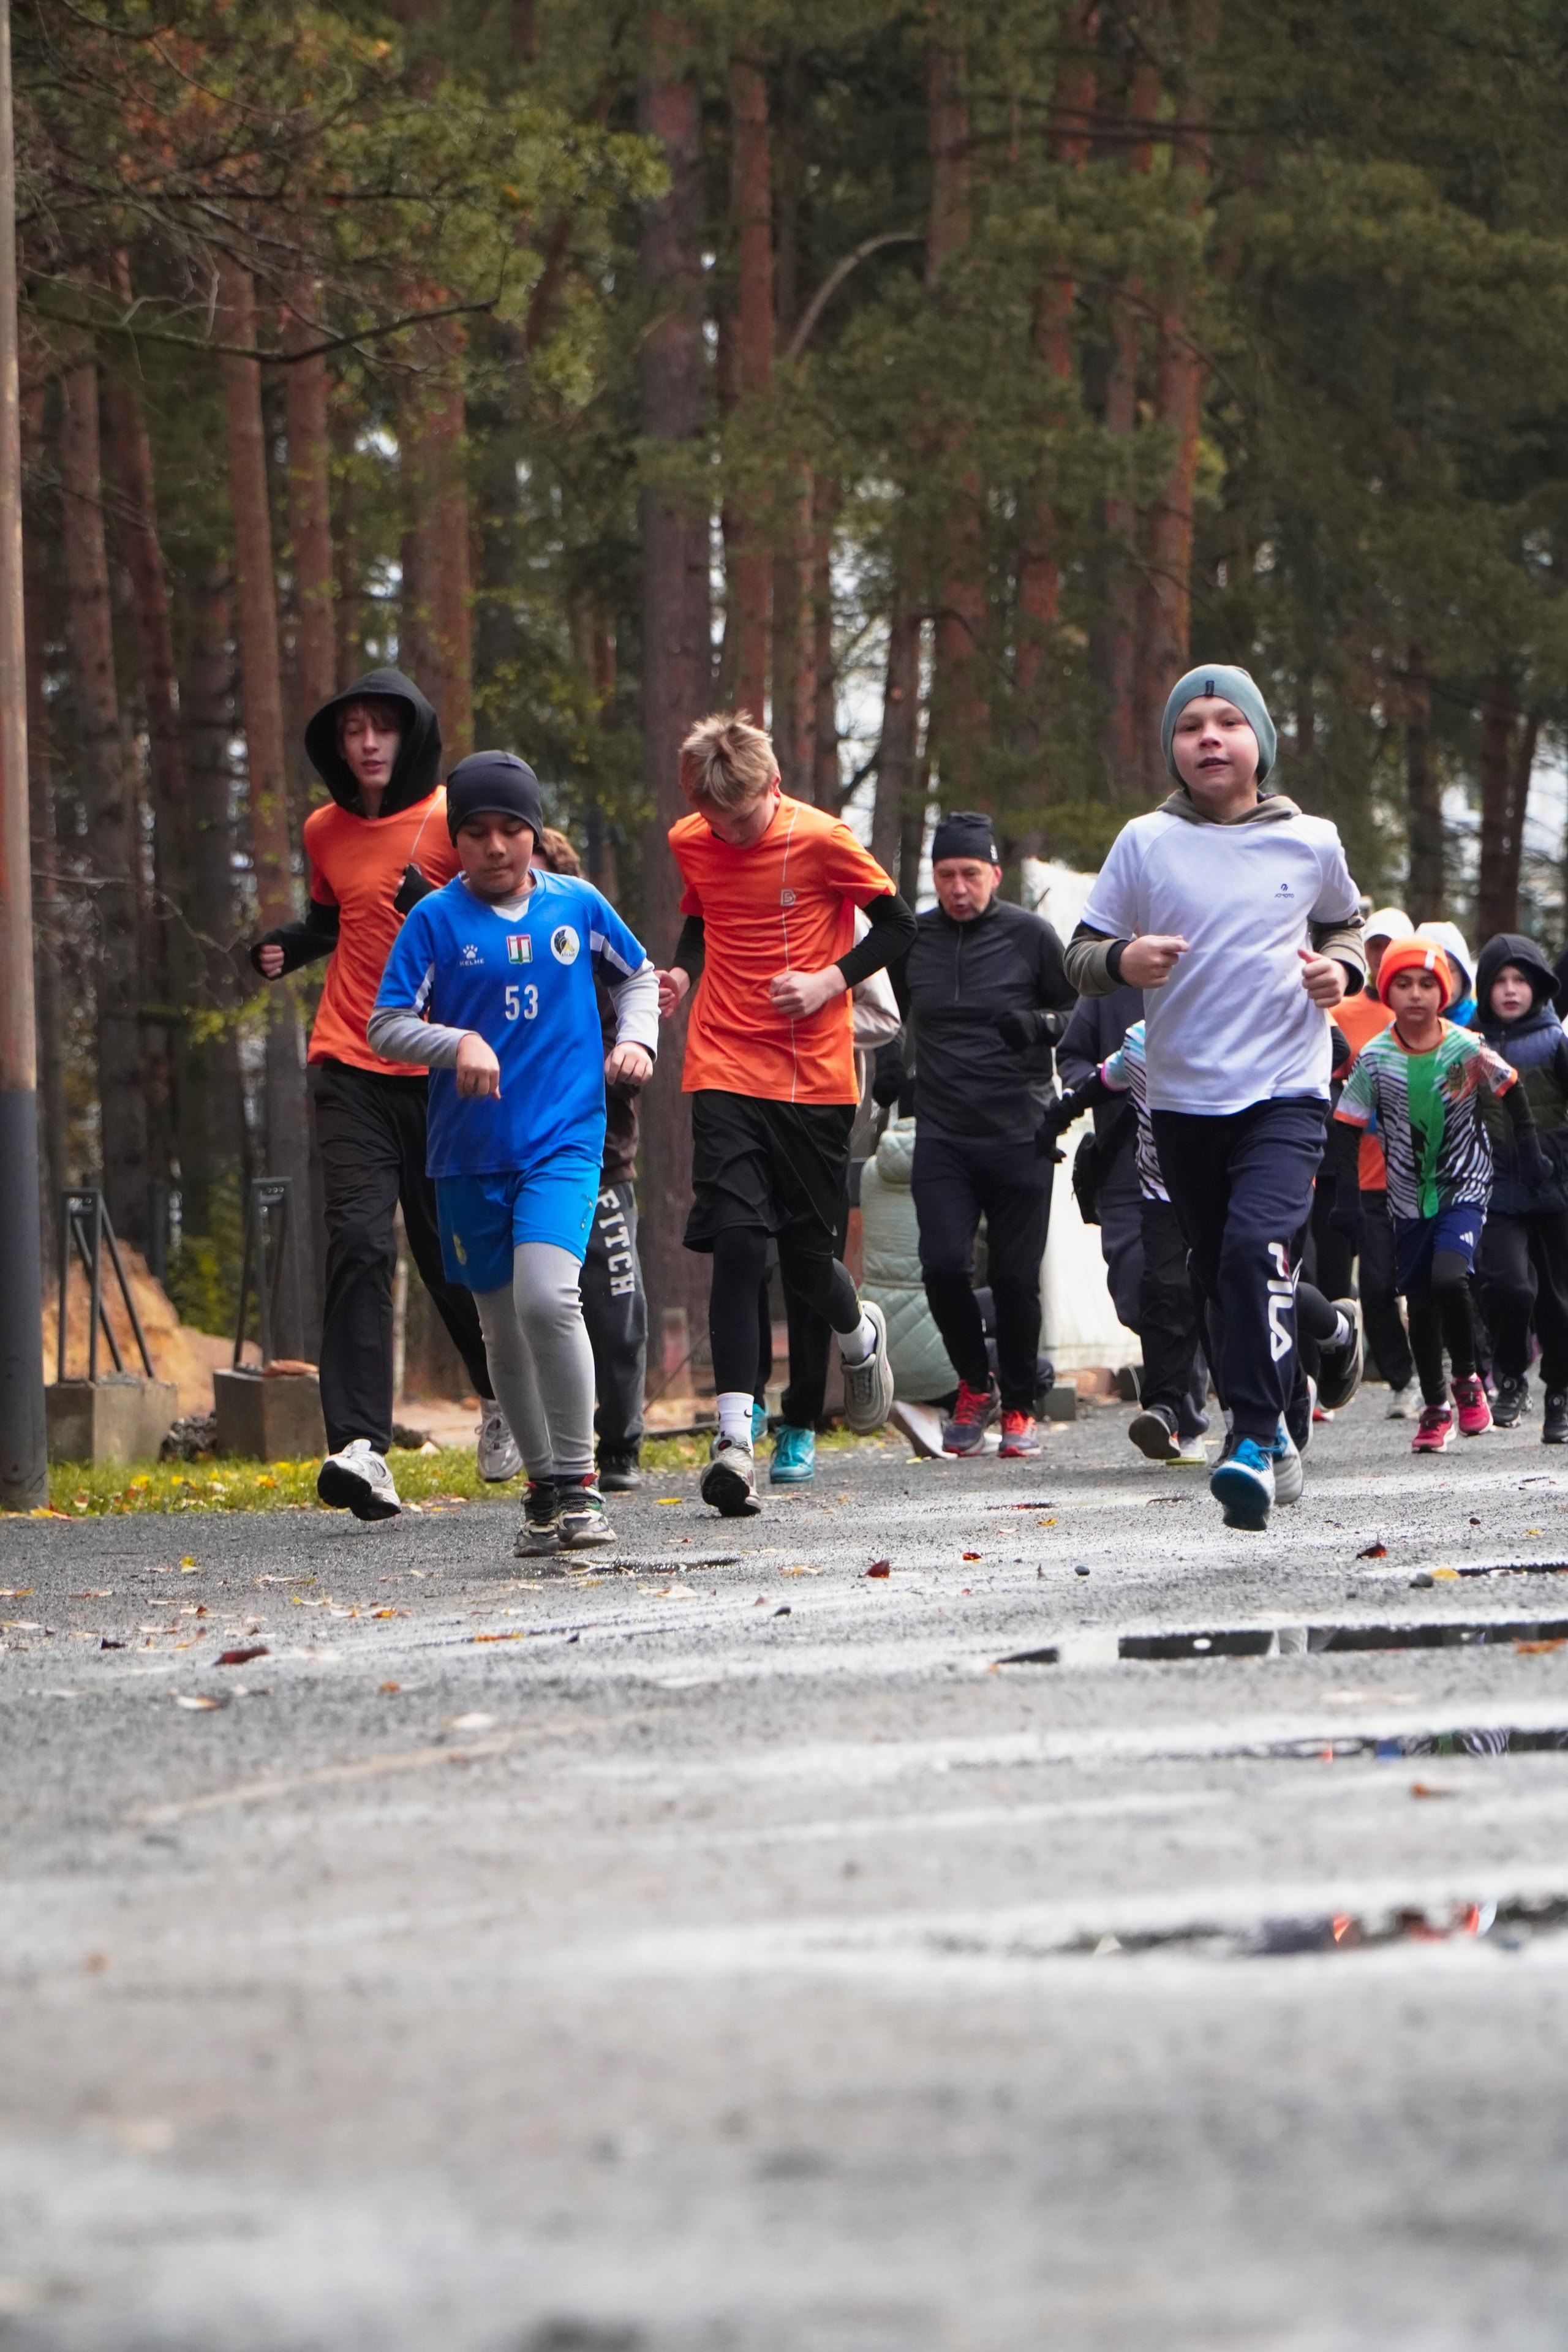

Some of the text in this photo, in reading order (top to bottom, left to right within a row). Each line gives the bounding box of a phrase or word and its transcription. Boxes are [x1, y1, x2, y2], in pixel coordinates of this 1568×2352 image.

[459, 958, 484, 967] KELME
[505, 984, 538, 1020] 53
[597, 1188, 636, 1296] FITCH
[1267, 1242, 1293, 1362] FILA
